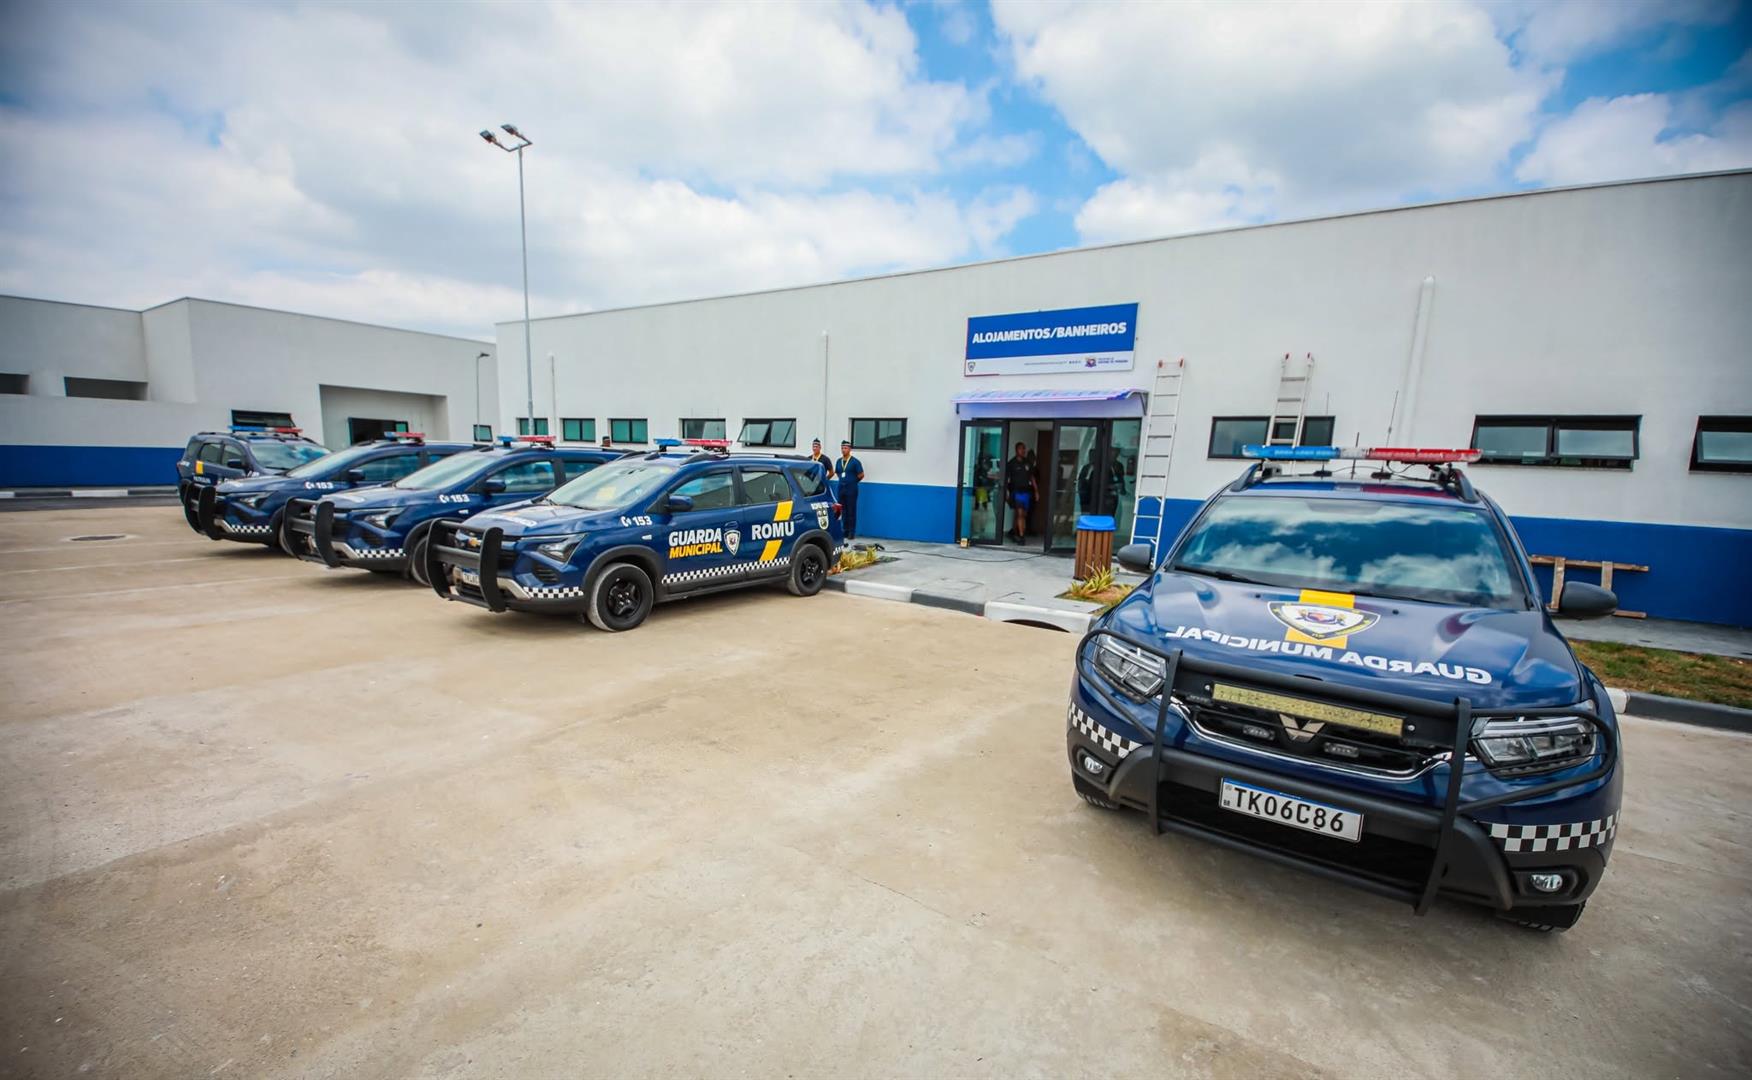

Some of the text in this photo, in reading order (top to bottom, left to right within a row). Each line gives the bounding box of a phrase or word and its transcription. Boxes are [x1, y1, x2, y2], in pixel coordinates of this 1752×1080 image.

[972, 322, 1127, 344] ALOJAMENTOS/BANHEIROS
[316, 482, 334, 490] 153
[451, 494, 470, 503] 153
[632, 515, 653, 526] 153
[668, 527, 722, 547] GUARDA
[751, 521, 795, 541] ROMU
[669, 542, 723, 560] MUNICIPAL
